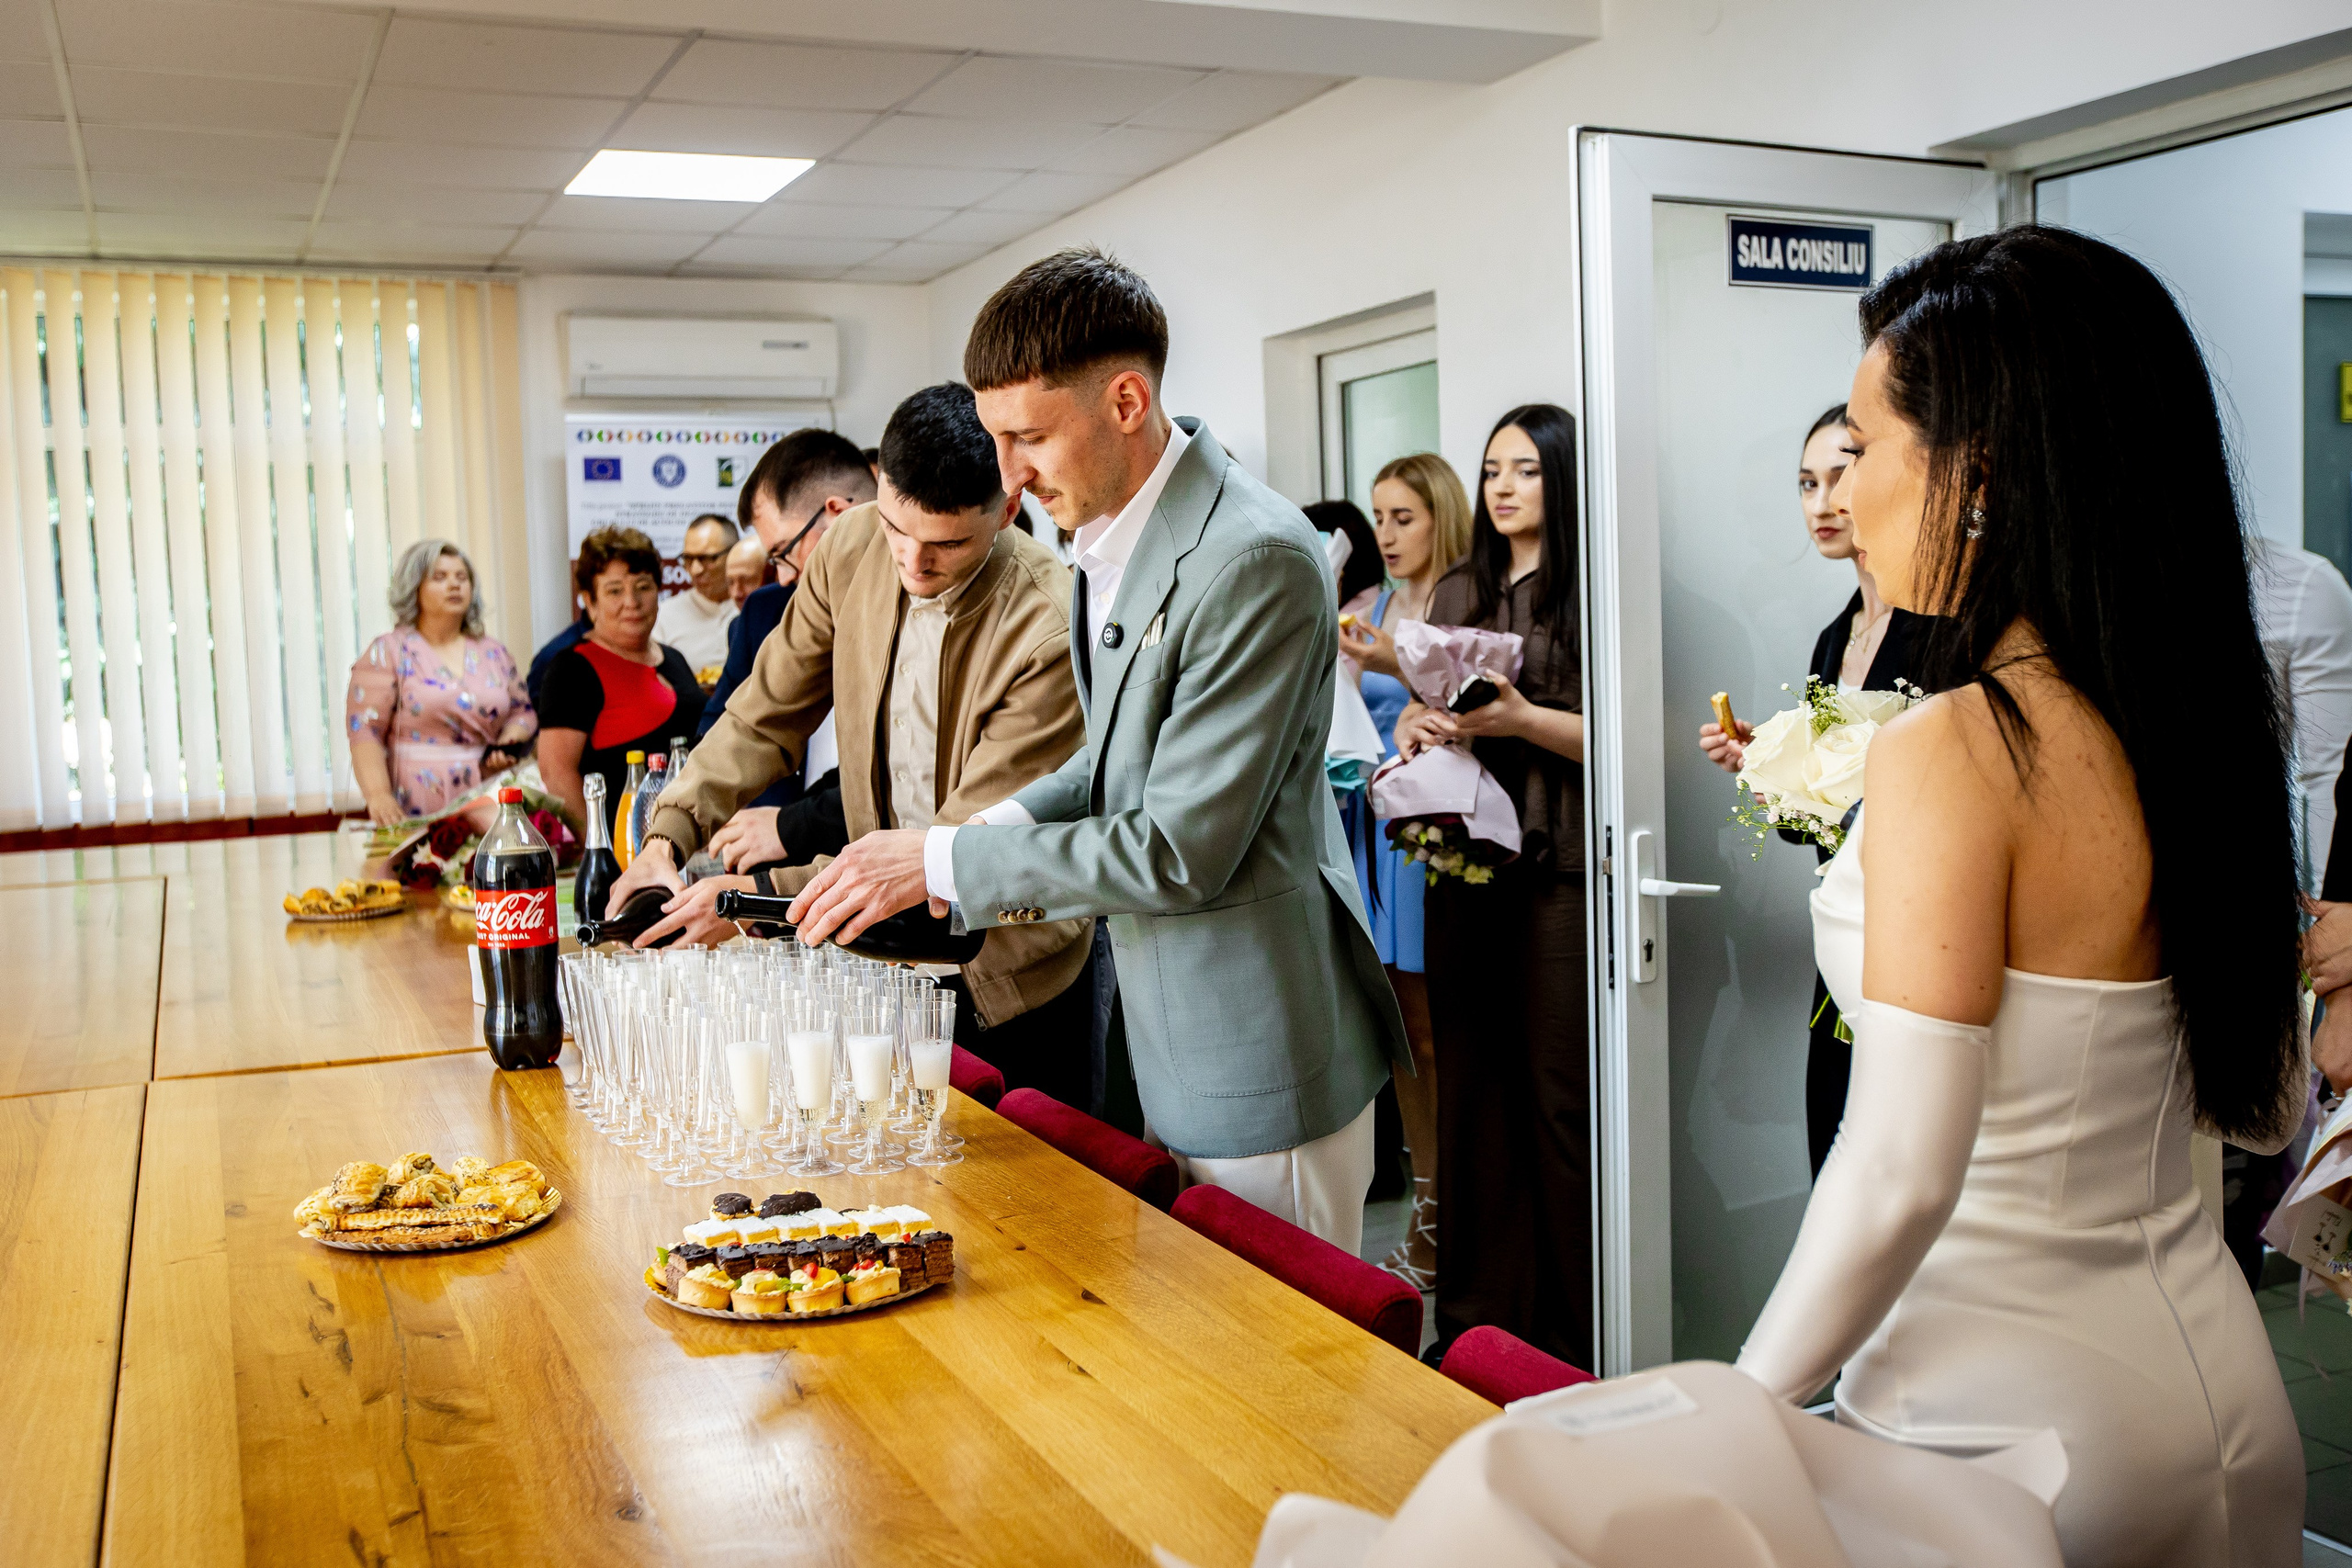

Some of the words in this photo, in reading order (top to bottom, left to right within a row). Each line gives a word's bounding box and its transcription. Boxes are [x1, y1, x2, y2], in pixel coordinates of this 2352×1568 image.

[1737, 233, 1784, 270] SALA
[1786, 237, 1866, 275] CONSILIU
[488, 932, 530, 942] ORIGINAL
